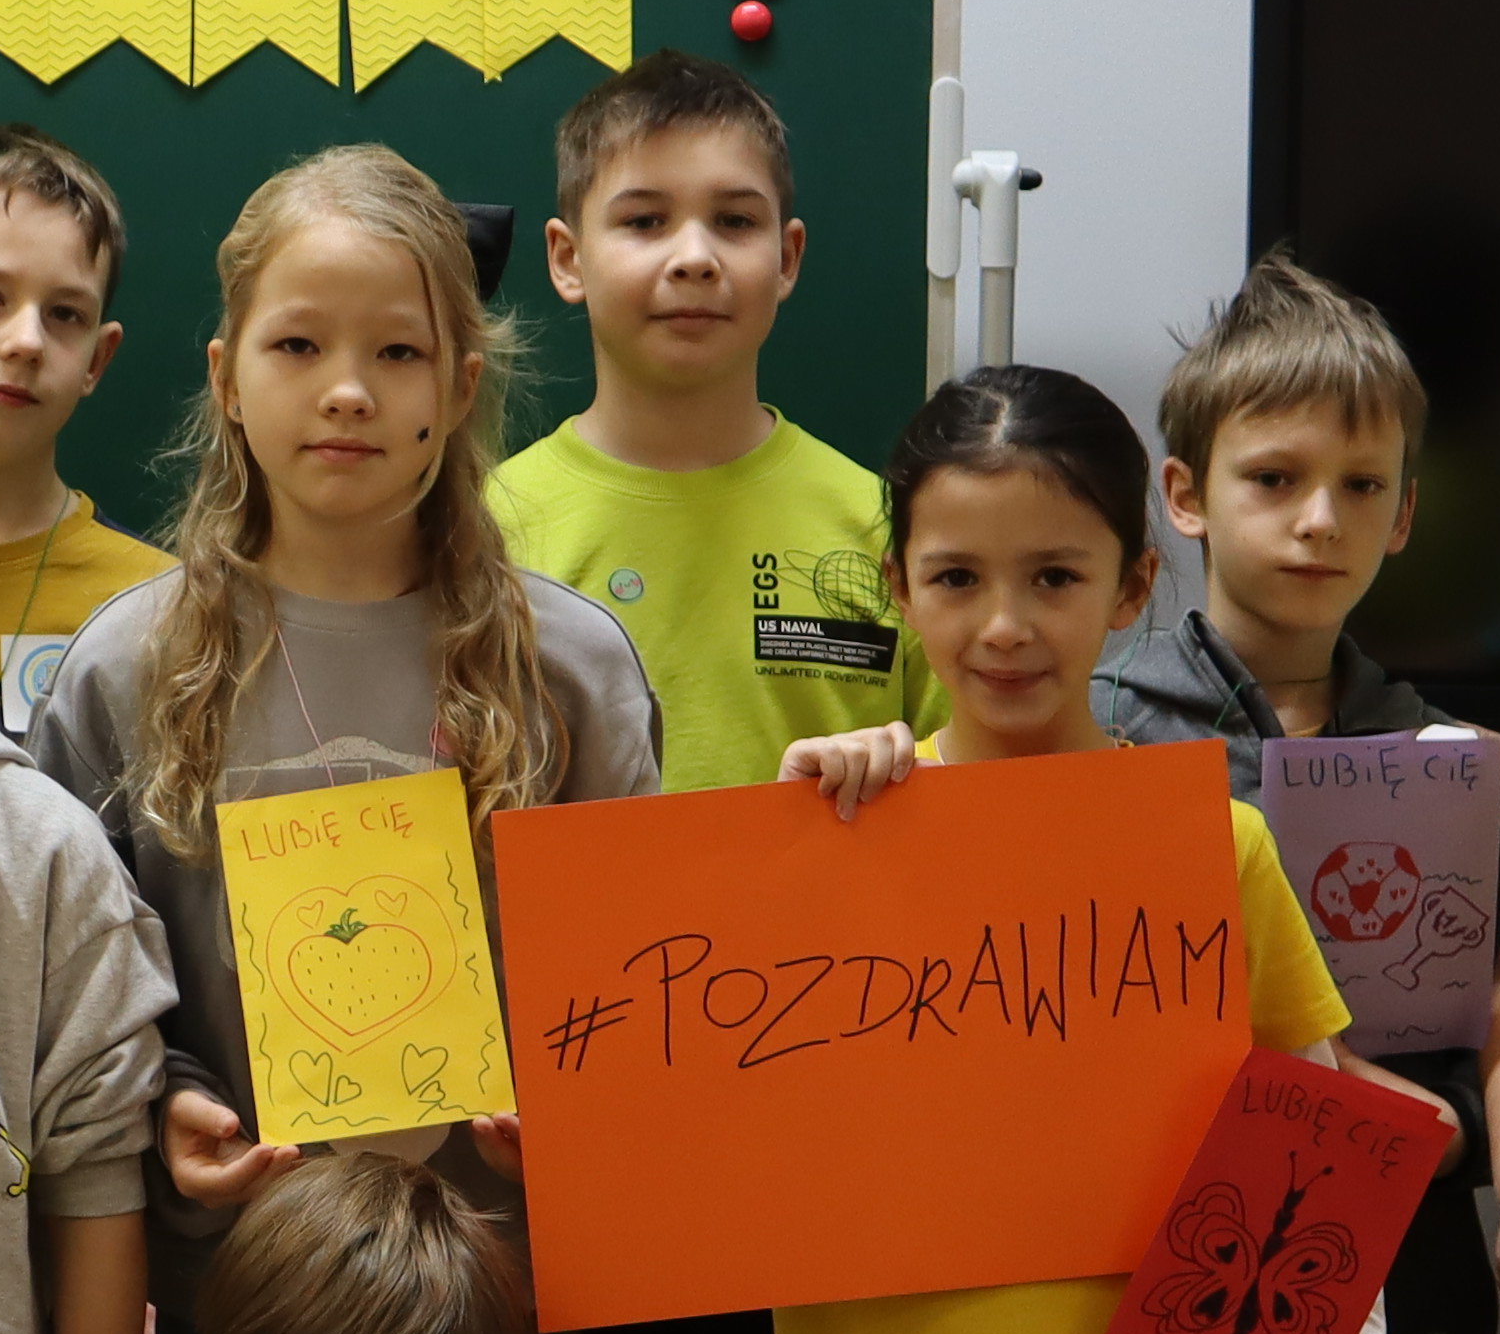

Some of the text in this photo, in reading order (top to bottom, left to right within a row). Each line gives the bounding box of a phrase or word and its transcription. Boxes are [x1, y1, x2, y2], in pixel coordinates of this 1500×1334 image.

[752, 552, 779, 609] EGS
[758, 619, 825, 636] US NAVAL
[755, 666, 822, 679] UNLIMITED
[544, 898, 1229, 1072] #POZDRAWIAM
